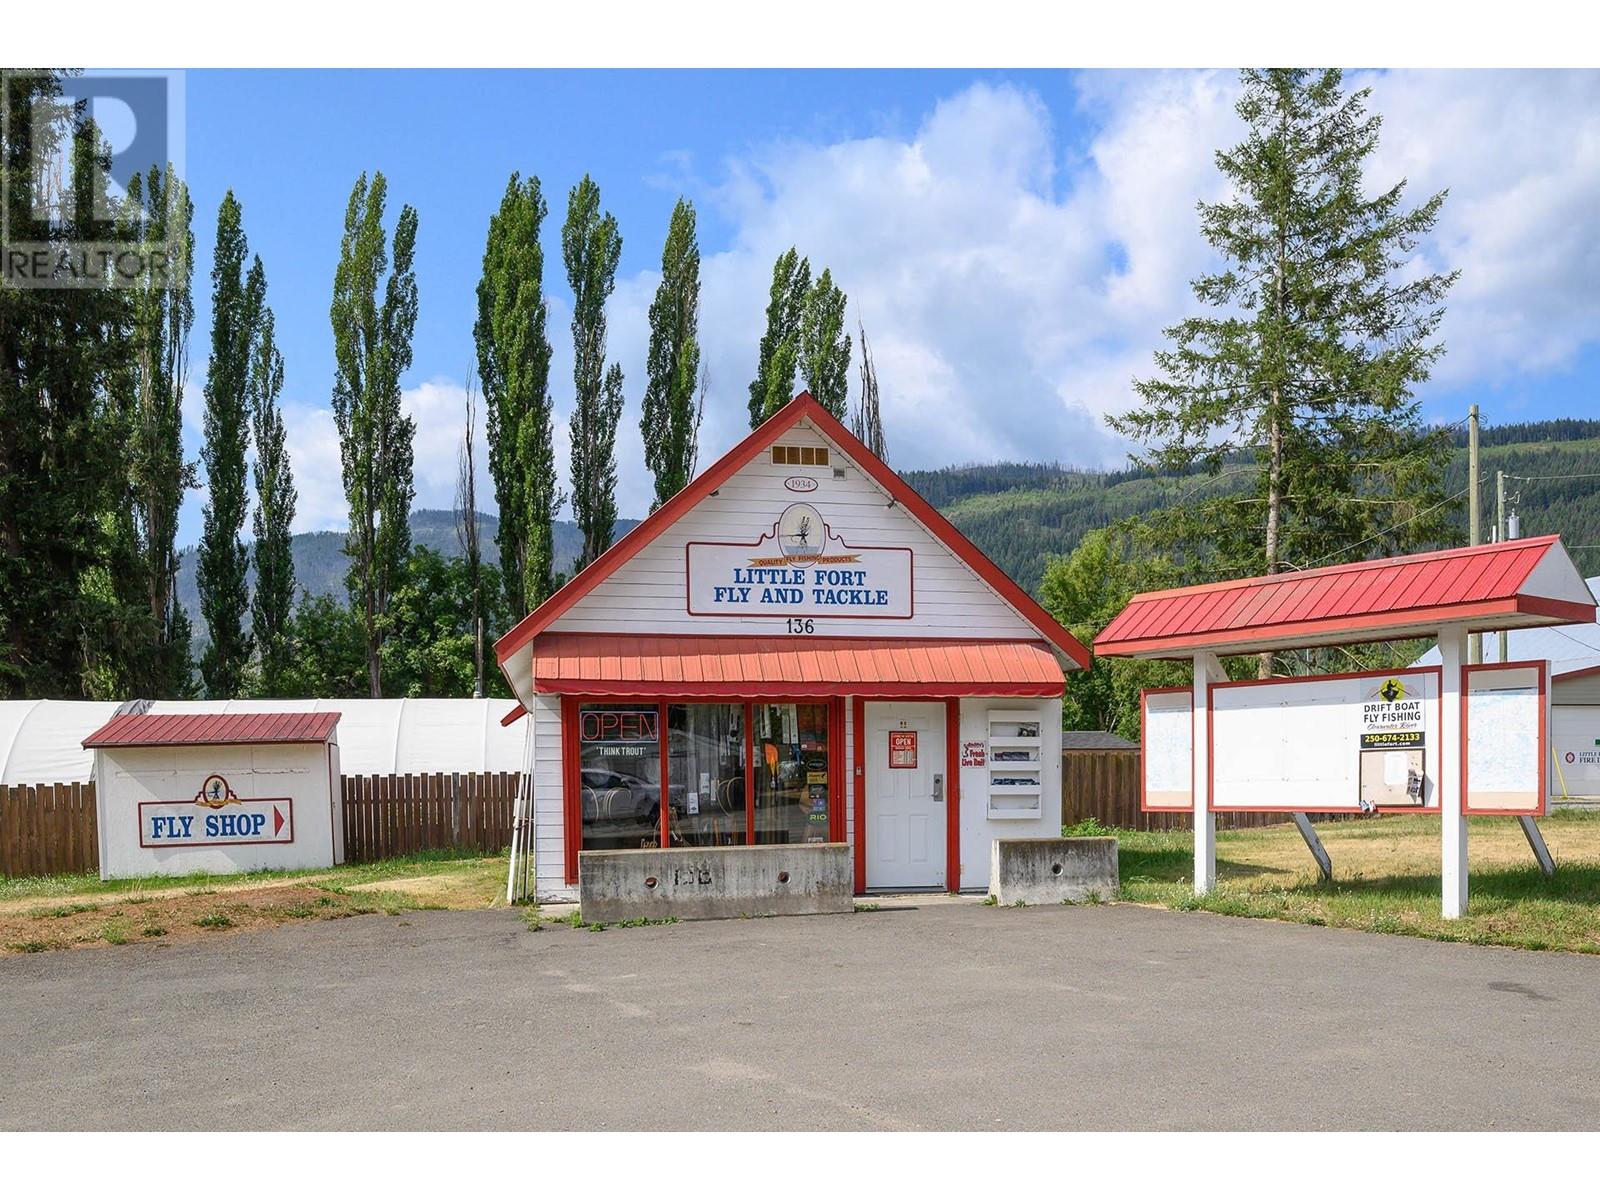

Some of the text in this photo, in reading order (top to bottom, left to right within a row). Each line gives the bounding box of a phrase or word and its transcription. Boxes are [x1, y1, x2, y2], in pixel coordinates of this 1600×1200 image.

[791, 480, 811, 488] 1934
[734, 568, 866, 586] LITTLE FORT
[714, 587, 888, 605] FLY AND TACKLE
[786, 619, 814, 634] 136
[1364, 702, 1420, 713] DRIFT BOAT
[1364, 711, 1421, 723] FLY FISHING
[582, 713, 656, 740] OPEN
[895, 737, 911, 746] OPEN
[1365, 733, 1420, 743] 250-674-2133
[151, 814, 266, 839] FLY SHOP
